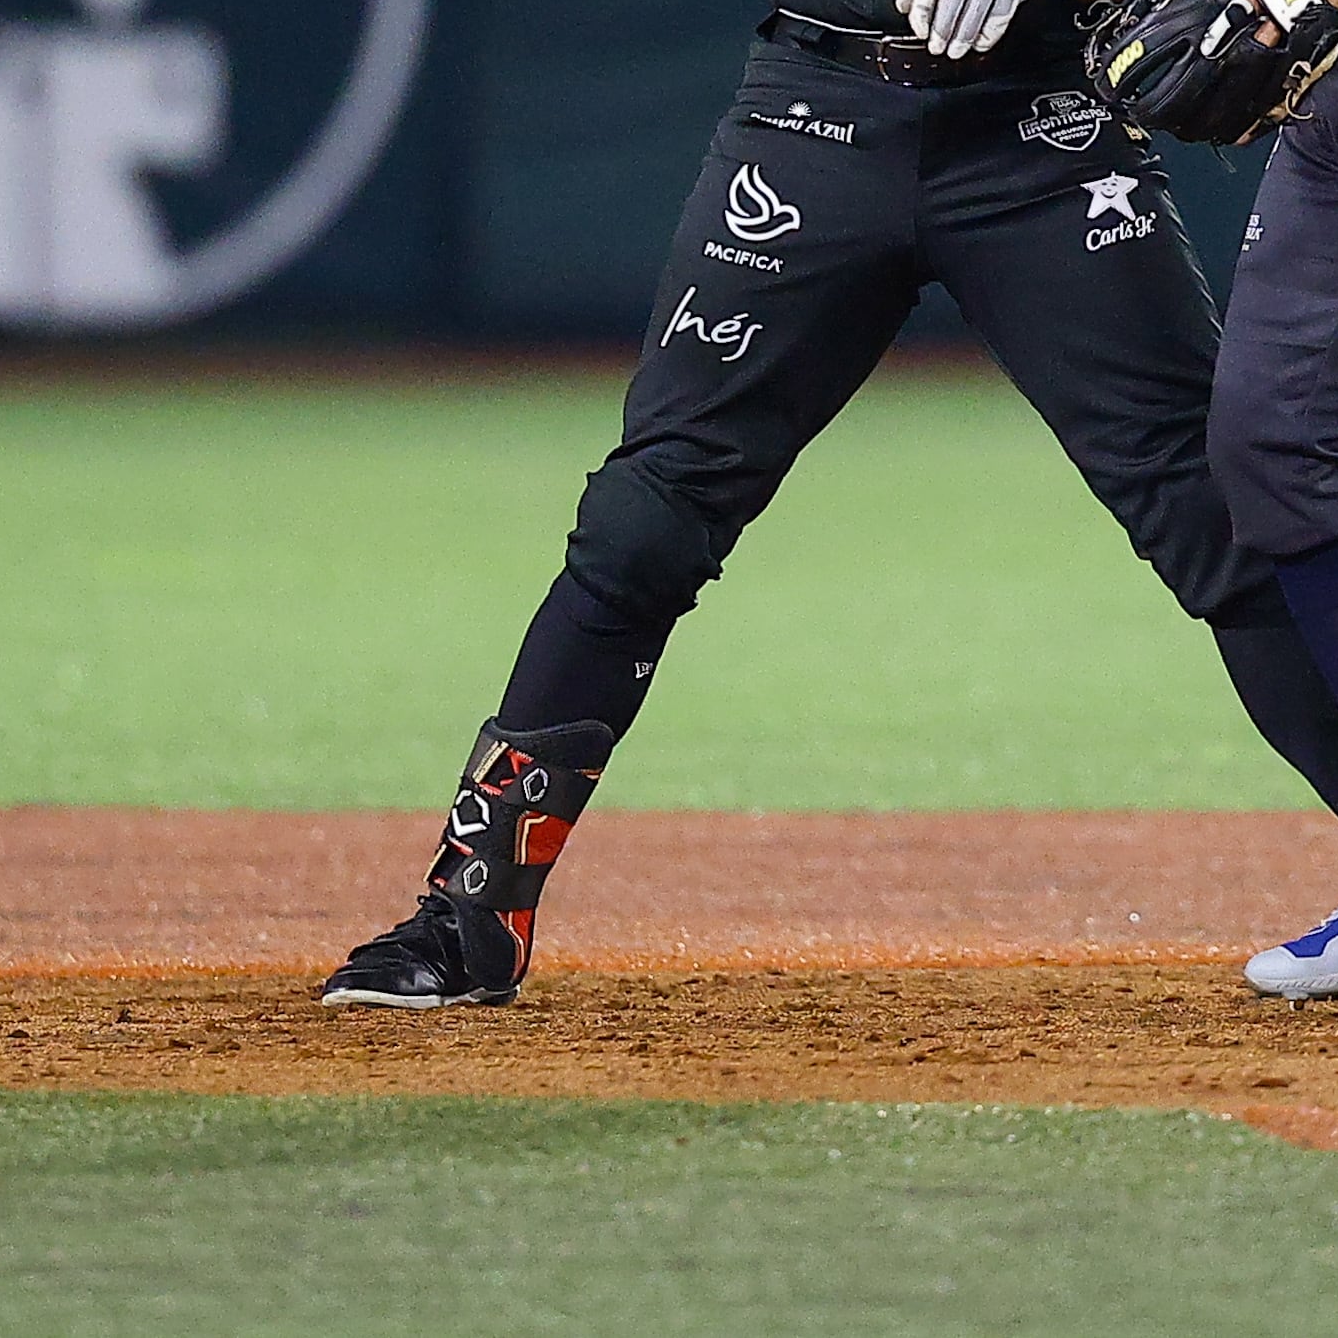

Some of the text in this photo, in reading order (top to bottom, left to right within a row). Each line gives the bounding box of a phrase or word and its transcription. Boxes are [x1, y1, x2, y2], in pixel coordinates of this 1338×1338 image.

[804, 120, 855, 144] Azul
[704, 241, 782, 274] PACIFICA
[660, 286, 764, 362] Inés
